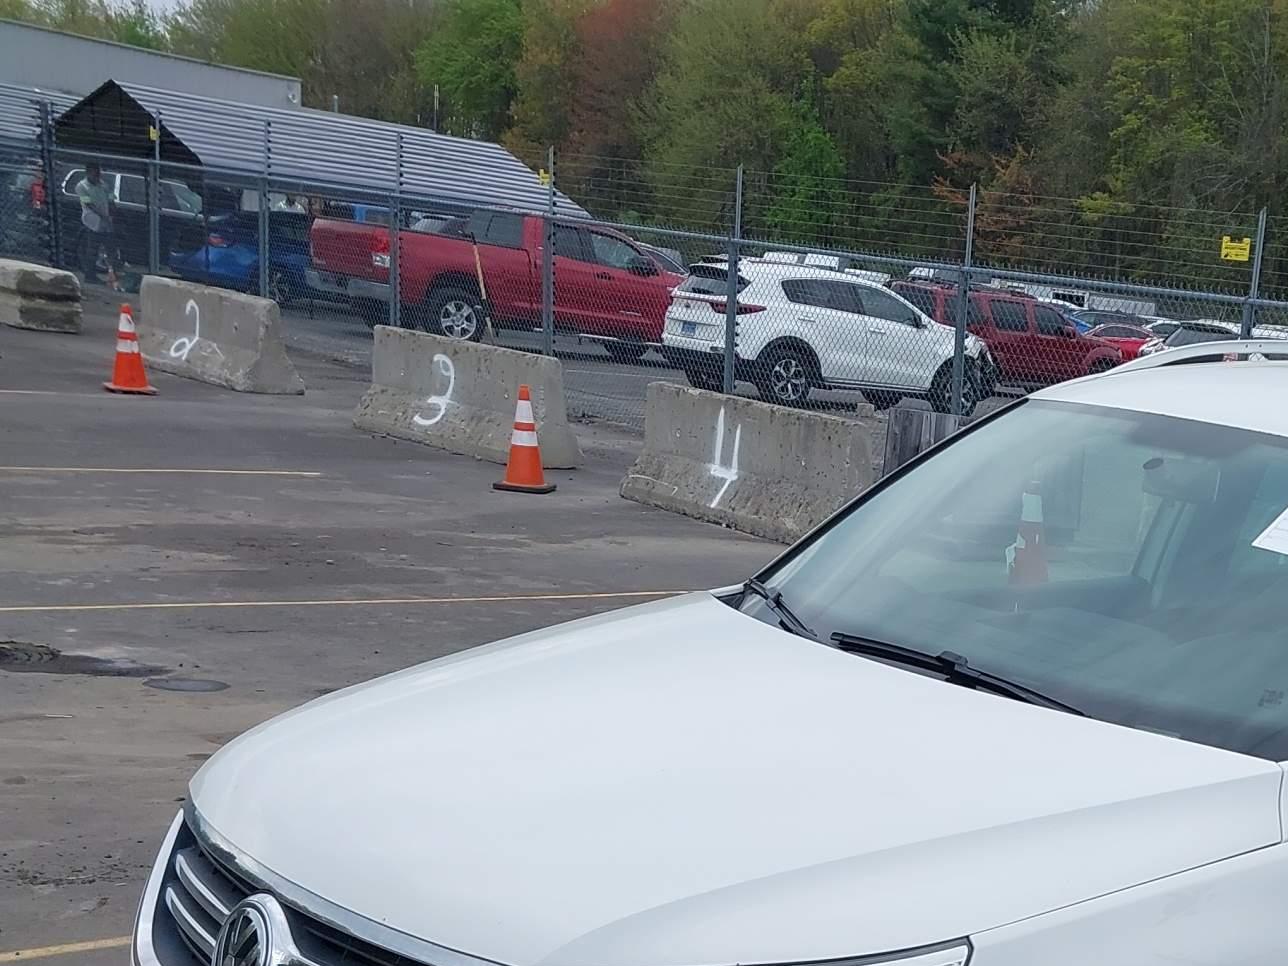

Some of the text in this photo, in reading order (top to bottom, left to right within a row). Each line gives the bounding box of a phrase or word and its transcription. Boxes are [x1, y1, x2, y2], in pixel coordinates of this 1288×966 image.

[169, 299, 200, 361] 2
[413, 353, 456, 426] 3
[710, 404, 741, 508] 4
